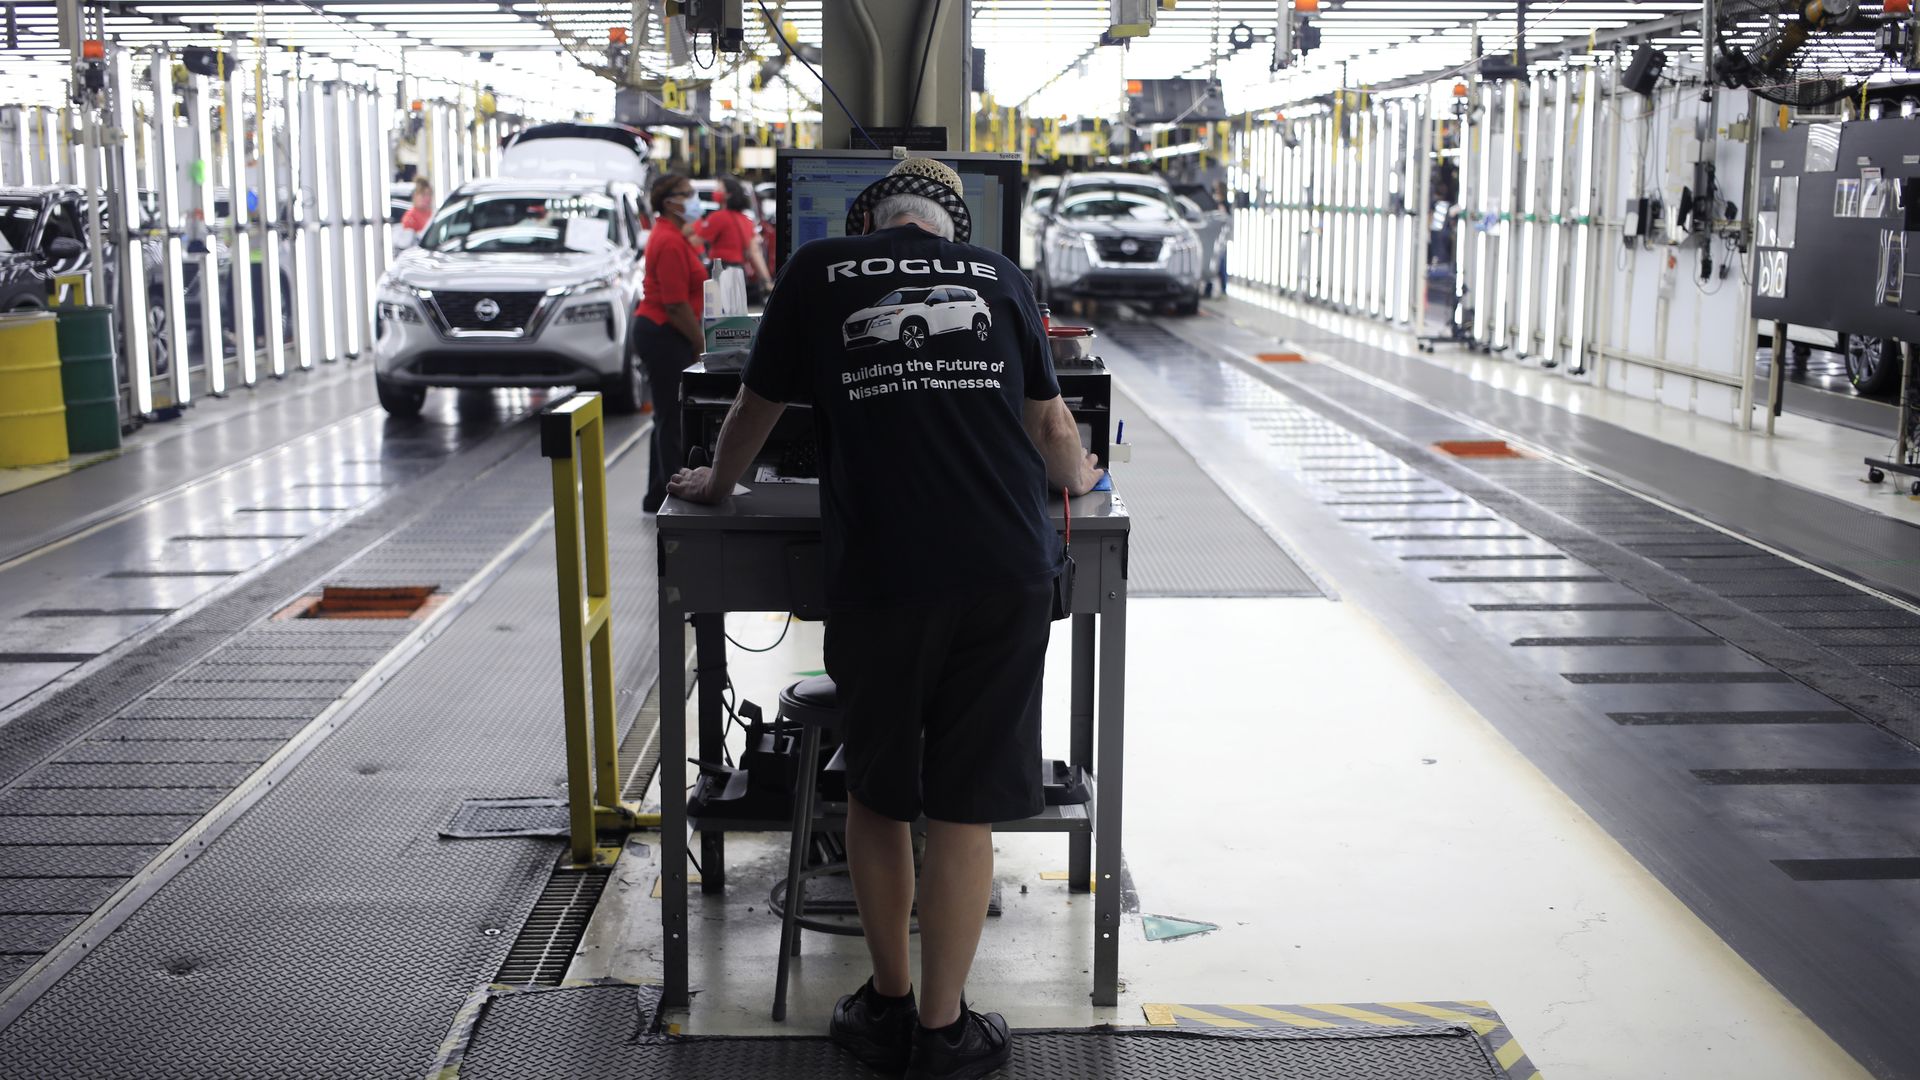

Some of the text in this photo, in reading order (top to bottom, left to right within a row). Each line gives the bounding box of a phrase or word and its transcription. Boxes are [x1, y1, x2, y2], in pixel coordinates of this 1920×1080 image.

[826, 257, 998, 283] ROGUE
[715, 329, 751, 337] KIMTECH
[841, 359, 1005, 384] Building the Future of
[849, 377, 1001, 401] Nissan in Tennessee
